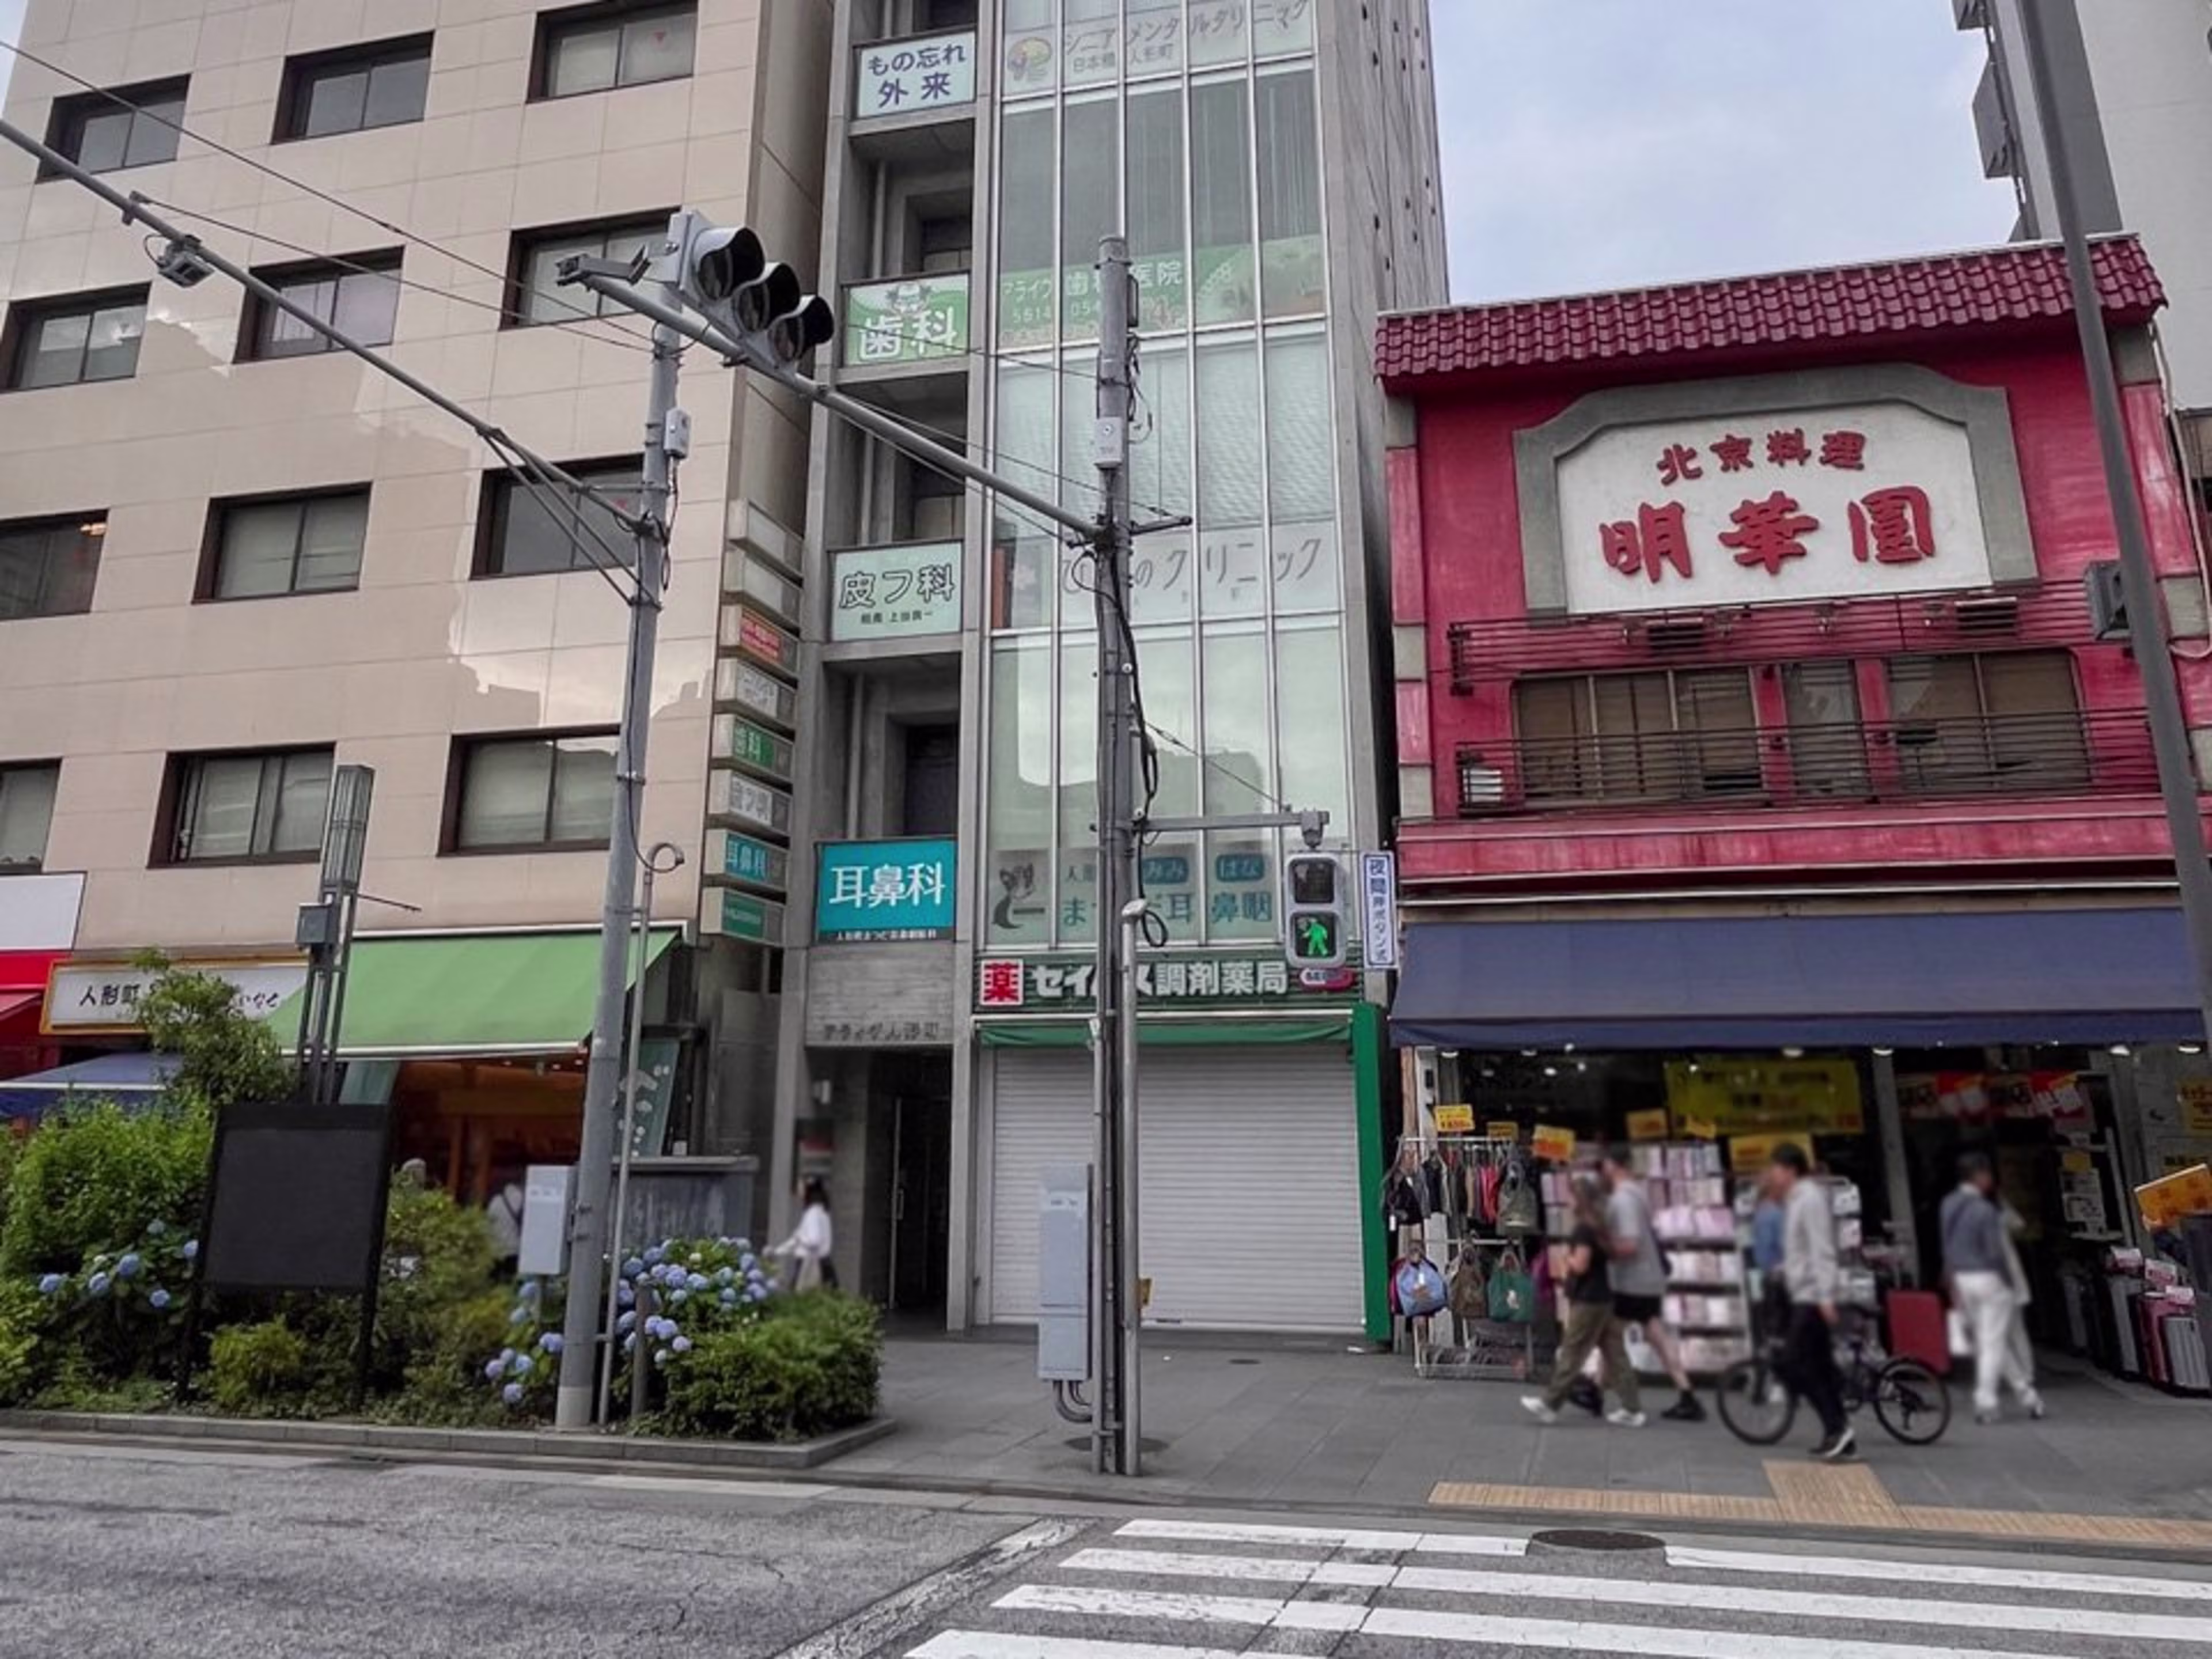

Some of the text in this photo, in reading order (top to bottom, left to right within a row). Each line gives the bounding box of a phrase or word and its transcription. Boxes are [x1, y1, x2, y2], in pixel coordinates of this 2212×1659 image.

[868, 44, 965, 76] もの忘れ
[878, 71, 950, 108] 外来
[859, 306, 957, 359] 歯科
[1656, 427, 1866, 486] 北京料理
[839, 563, 956, 609] 皮フ科
[1062, 539, 1321, 594] ひのクリニック
[828, 862, 946, 908] 耳鼻科
[79, 984, 141, 1006] 人形町
[984, 961, 1288, 1002] 薬 セイ調剤薬局
